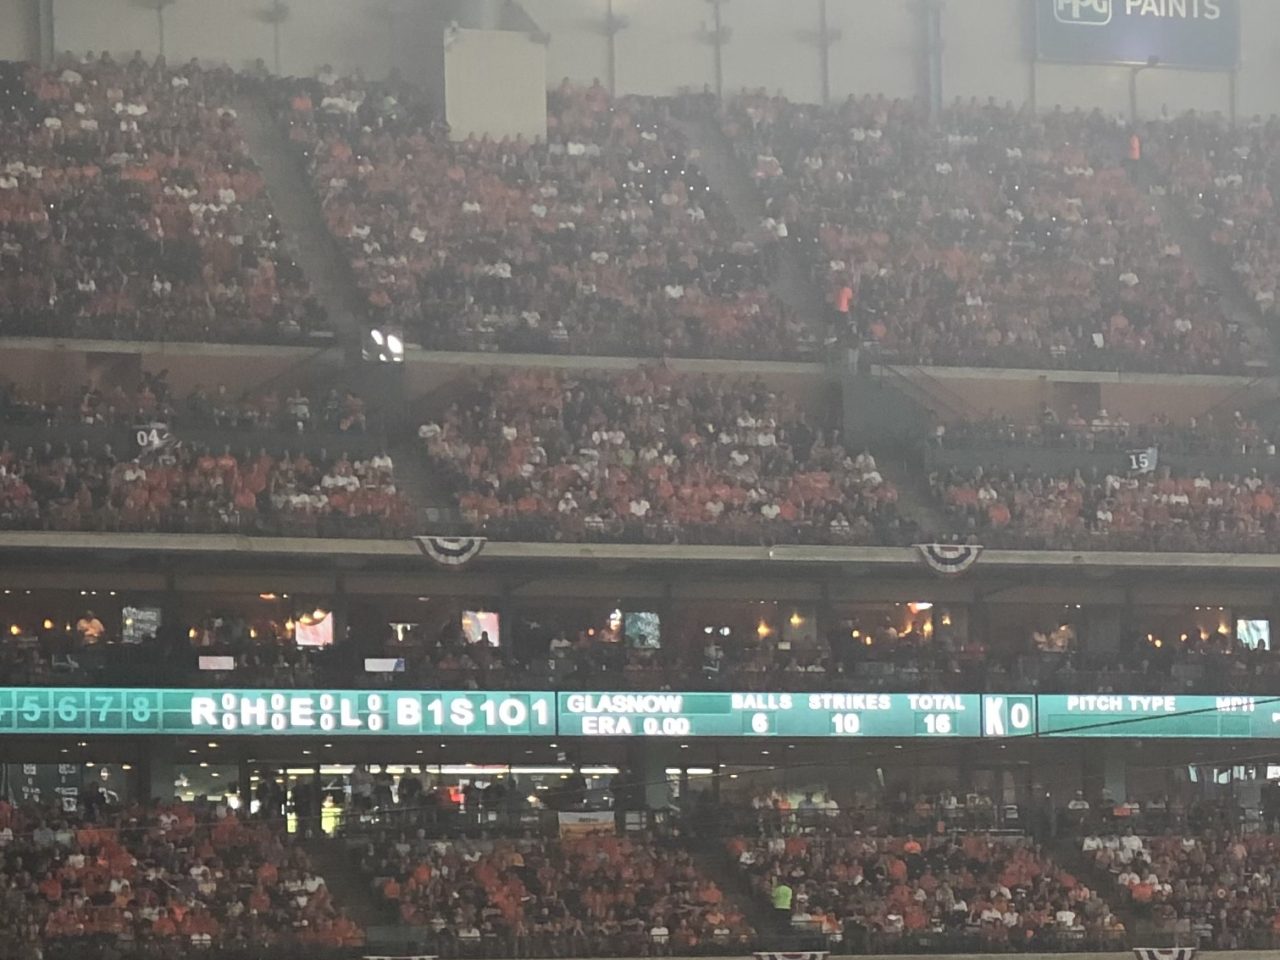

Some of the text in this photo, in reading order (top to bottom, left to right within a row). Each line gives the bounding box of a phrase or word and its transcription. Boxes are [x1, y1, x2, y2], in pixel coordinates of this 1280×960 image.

[1126, 0, 1220, 19] PAINTS
[1129, 454, 1149, 469] 15
[23, 696, 41, 721] 5
[58, 696, 78, 721] 6
[95, 696, 114, 722] 7
[132, 696, 151, 722] 8
[566, 695, 683, 713] GLASNOW
[731, 693, 965, 710] BALLS STRIKES TOTAL
[1067, 695, 1255, 712] PITCH TYPE MPH
[191, 697, 362, 726] R H E L
[985, 697, 1004, 736] K
[582, 716, 691, 735] ERA 0.00
[752, 712, 951, 734] 6 10 16
